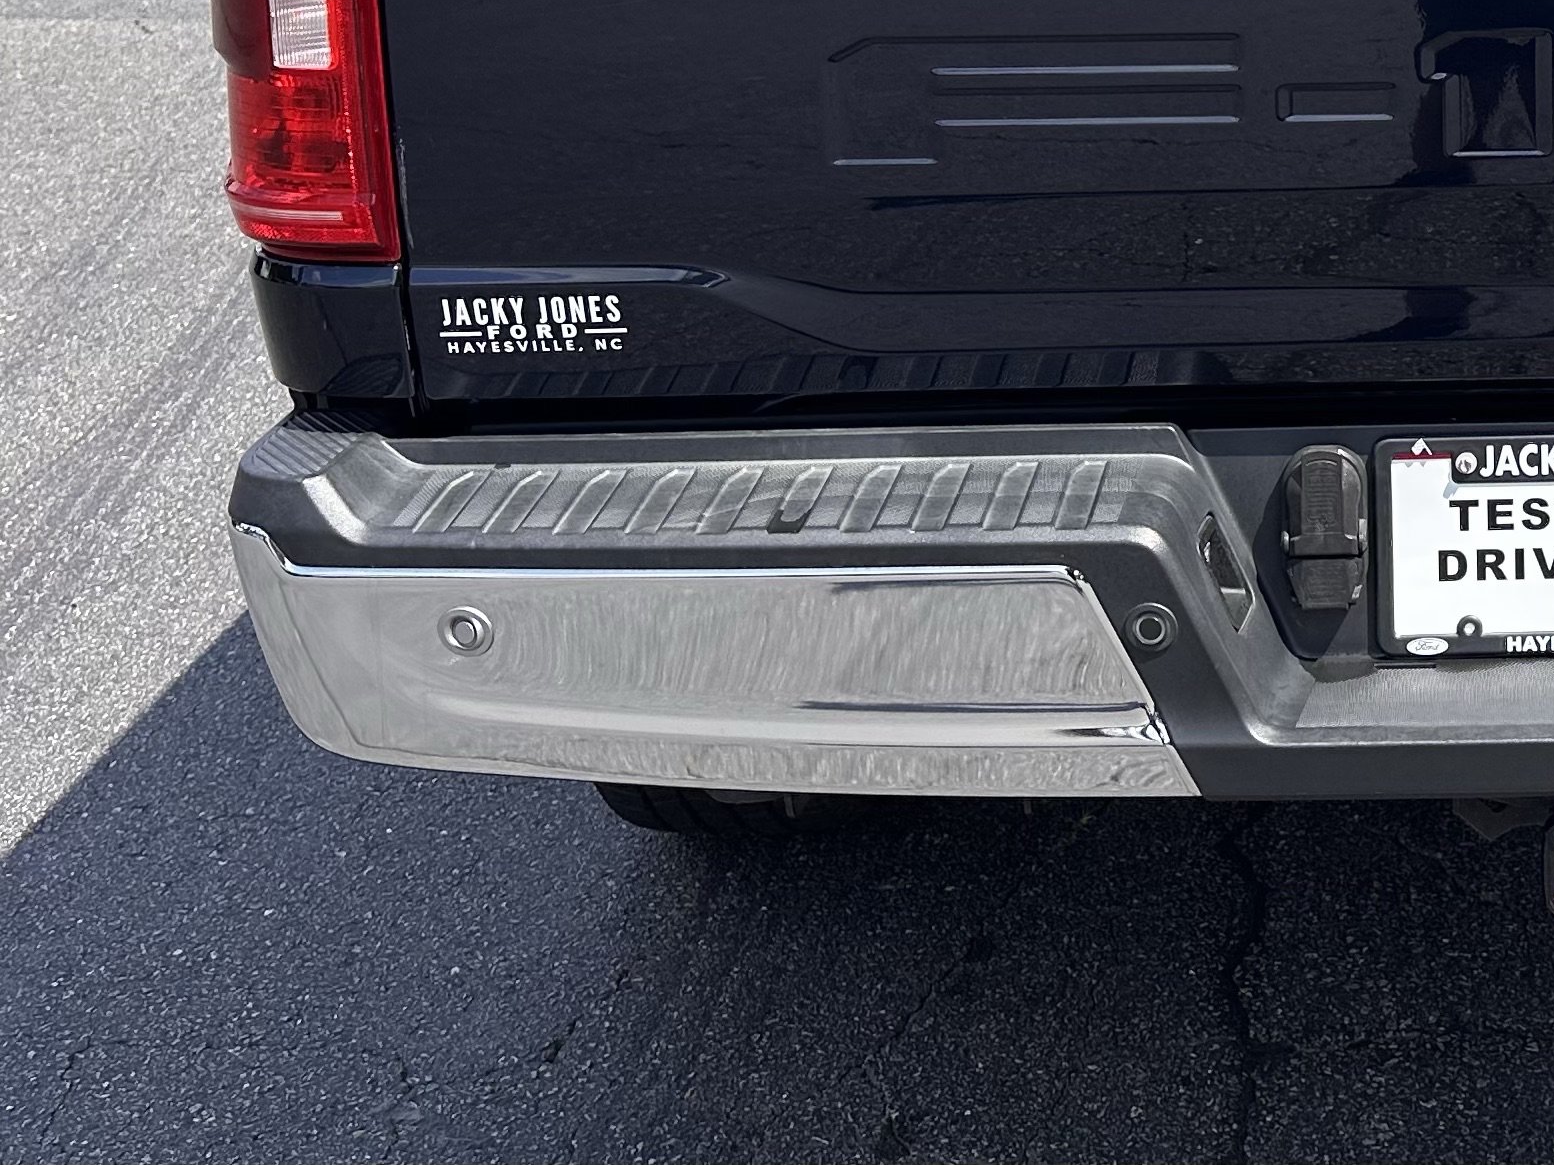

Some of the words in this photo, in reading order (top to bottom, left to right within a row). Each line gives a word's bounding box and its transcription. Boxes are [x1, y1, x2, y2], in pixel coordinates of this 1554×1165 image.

[441, 296, 524, 326] JACKY
[538, 295, 622, 324] JONES
[487, 324, 578, 340] FORD
[447, 339, 584, 354] HAYESVILLE,
[595, 338, 623, 351] NC
